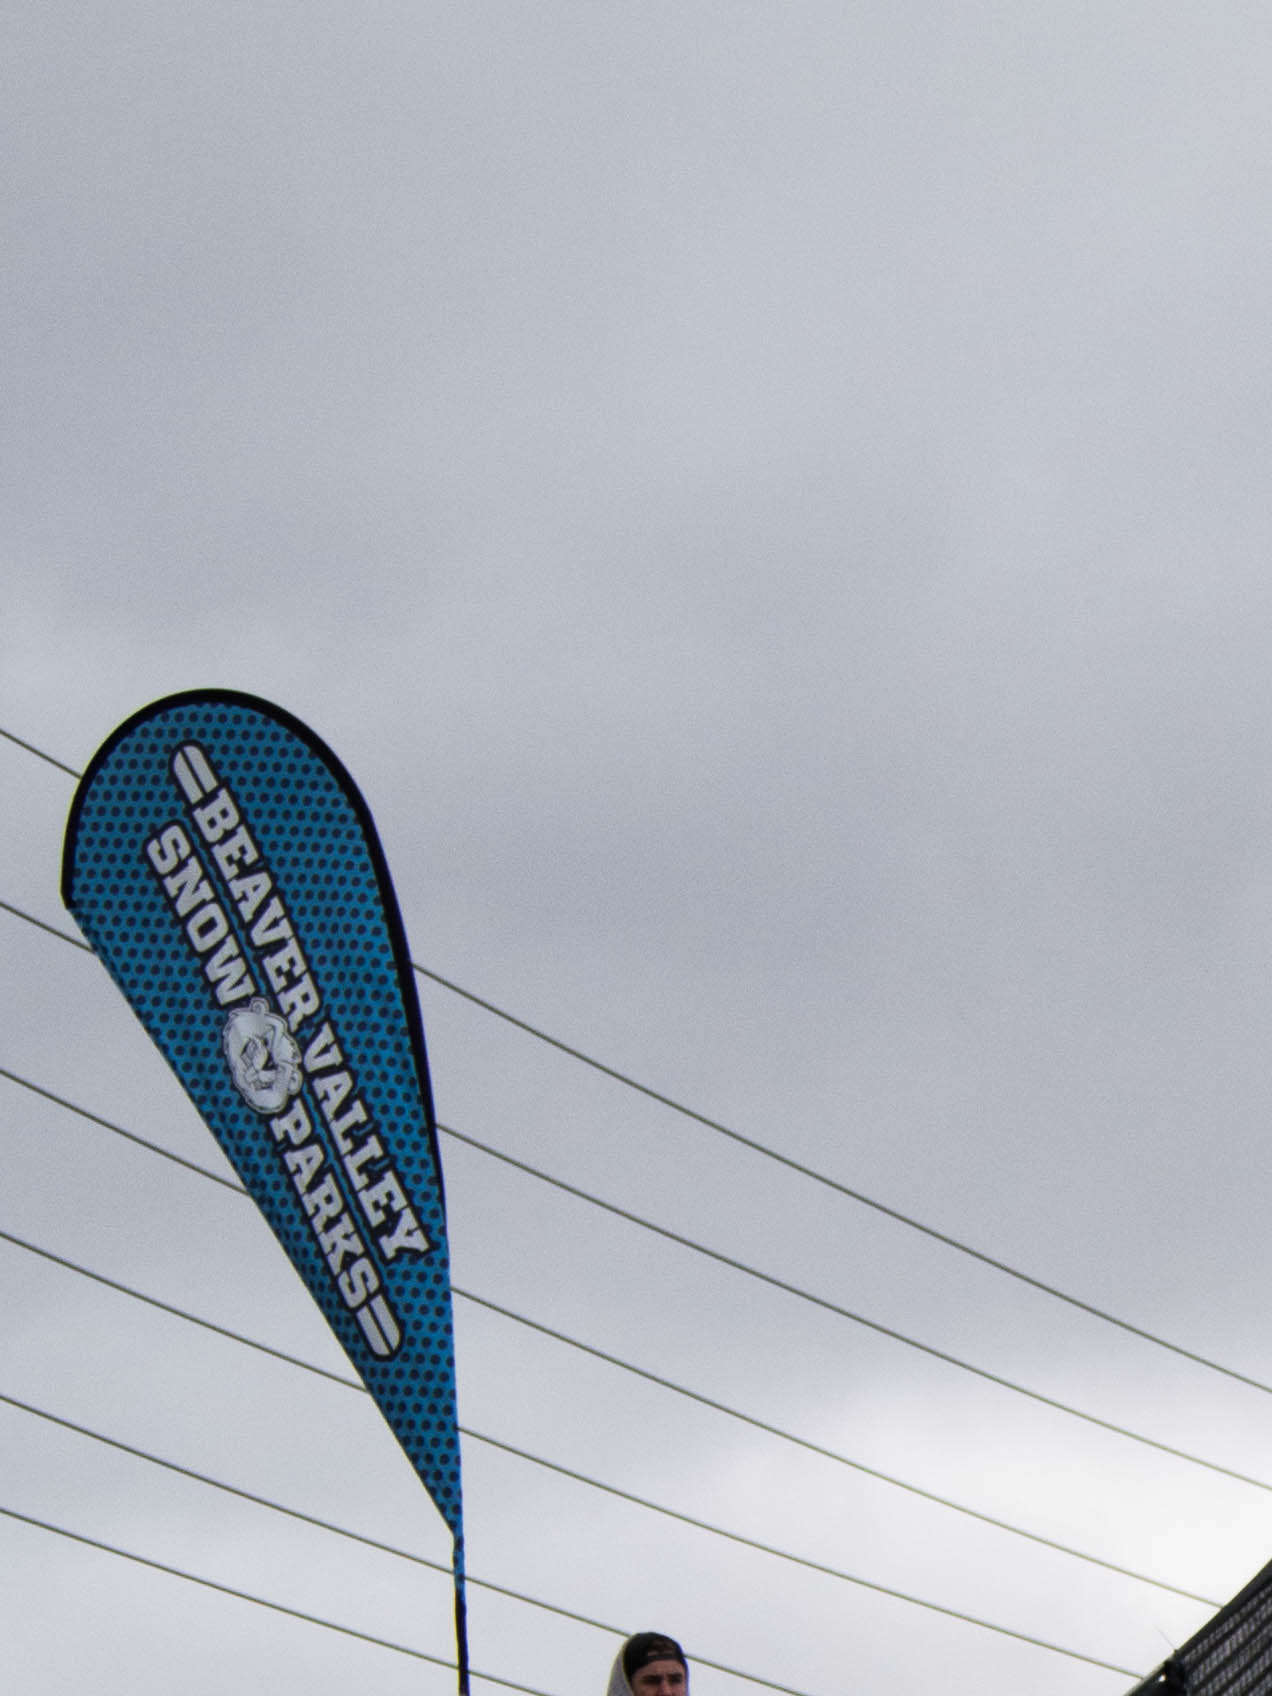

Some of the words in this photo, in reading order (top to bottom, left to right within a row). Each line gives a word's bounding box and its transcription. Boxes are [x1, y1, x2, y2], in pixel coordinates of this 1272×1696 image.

[146, 823, 257, 1006] SNOW
[269, 1098, 381, 1309] PARKS
[192, 787, 321, 1033] BEAVER
[303, 1021, 431, 1261] VALLEY
